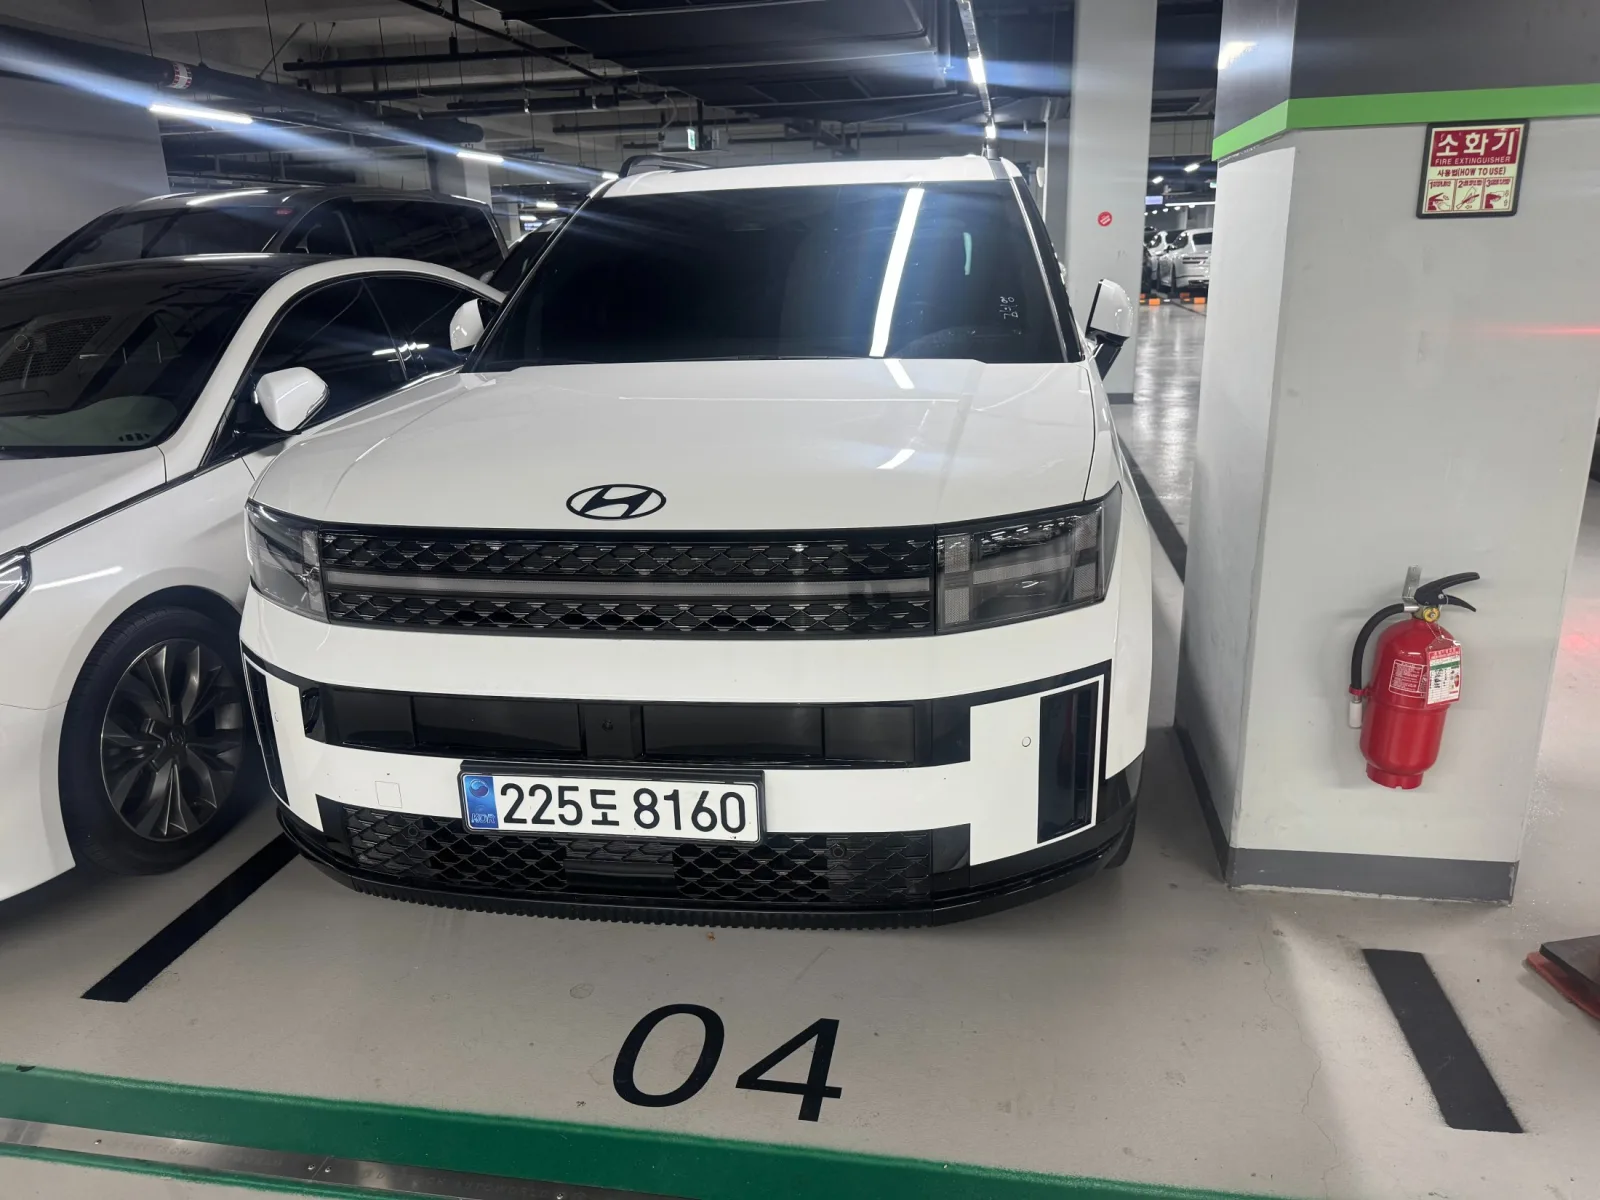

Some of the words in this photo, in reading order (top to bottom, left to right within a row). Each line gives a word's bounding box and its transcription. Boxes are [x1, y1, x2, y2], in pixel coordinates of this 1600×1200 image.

[1436, 131, 1515, 156] 소화기
[1454, 156, 1511, 165] EXTINGUISHER
[1478, 167, 1488, 176] TO
[1489, 166, 1506, 176] USE)
[500, 783, 620, 827] 225도
[633, 788, 747, 834] 8160
[470, 812, 497, 825] KOR
[612, 1003, 843, 1122] 04
